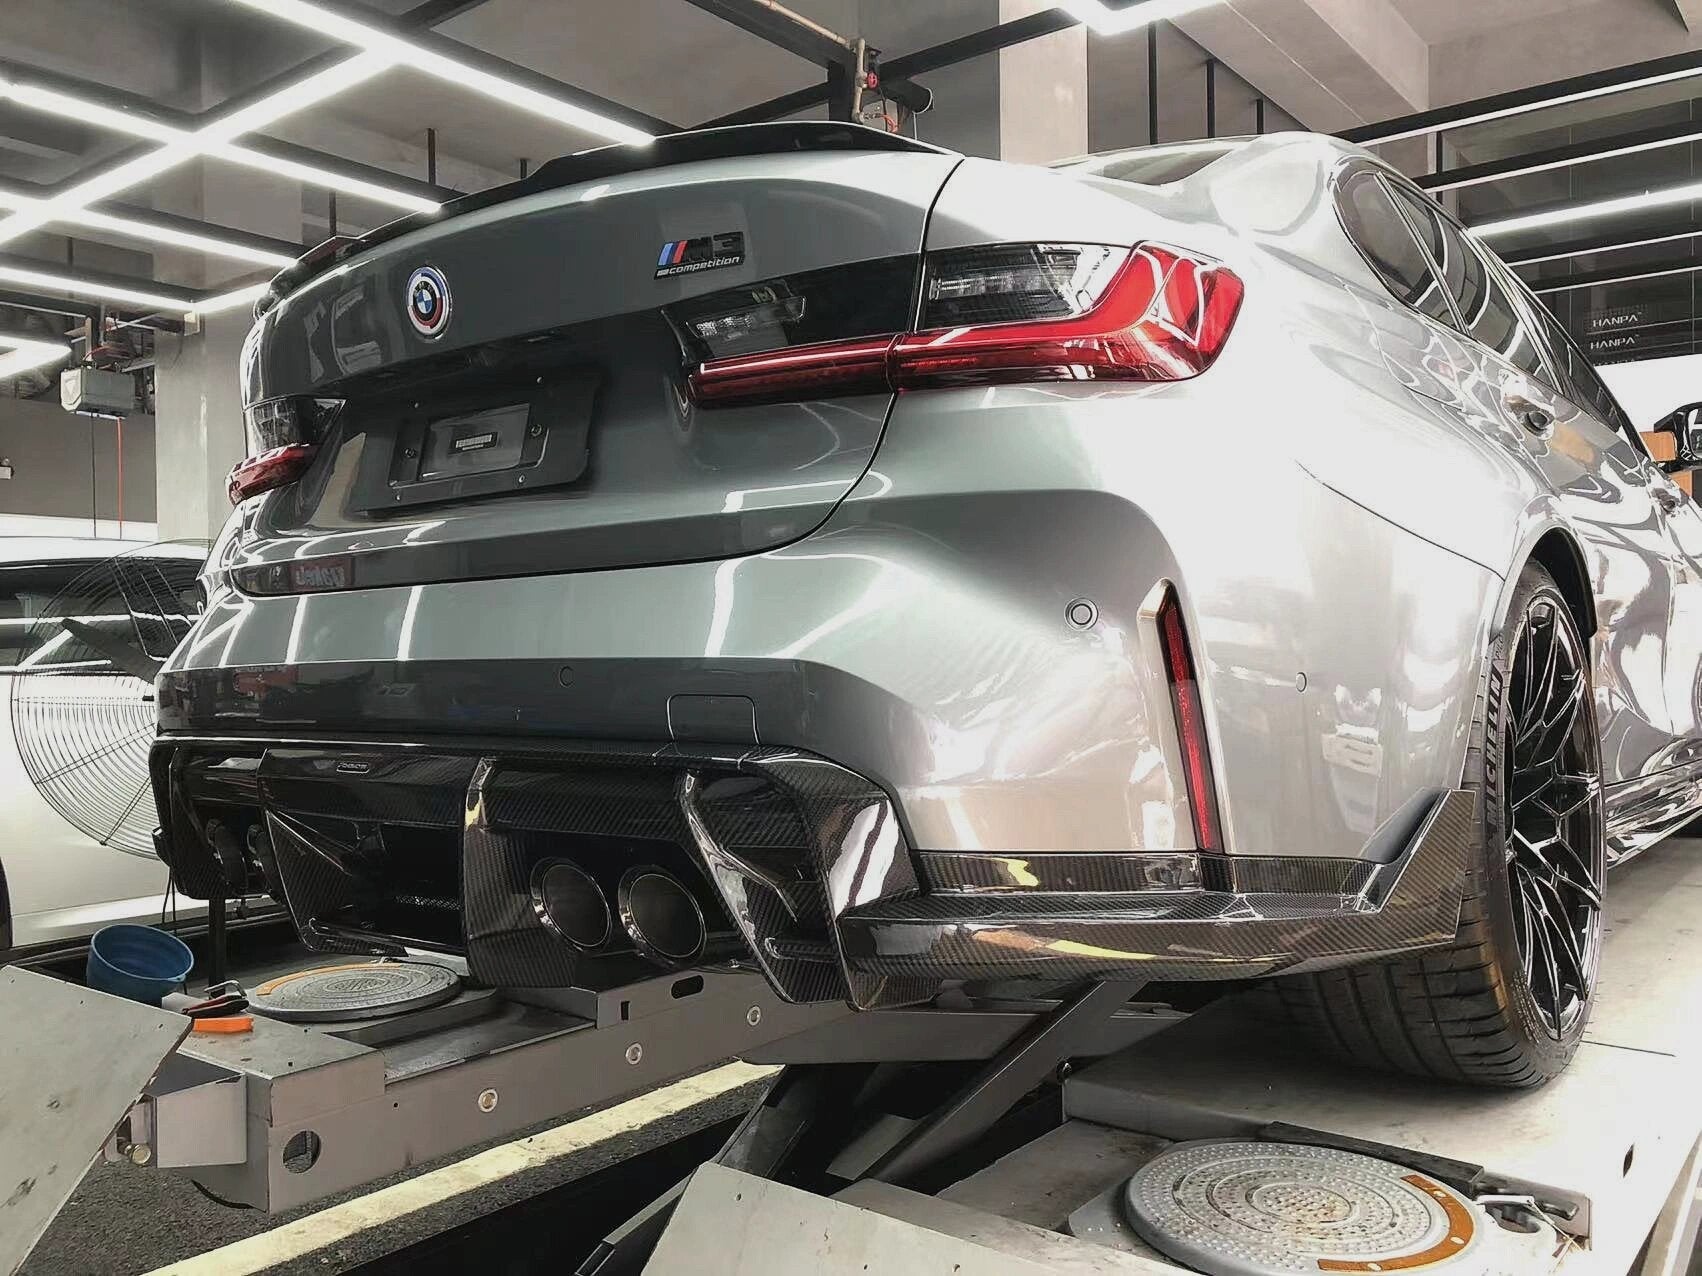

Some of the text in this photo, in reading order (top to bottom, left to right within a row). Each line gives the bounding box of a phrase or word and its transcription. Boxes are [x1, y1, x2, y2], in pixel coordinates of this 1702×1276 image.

[669, 256, 740, 275] competition
[1592, 314, 1638, 328] HANPA
[1589, 336, 1635, 350] HANPA
[1486, 670, 1503, 827] MICHELIN
